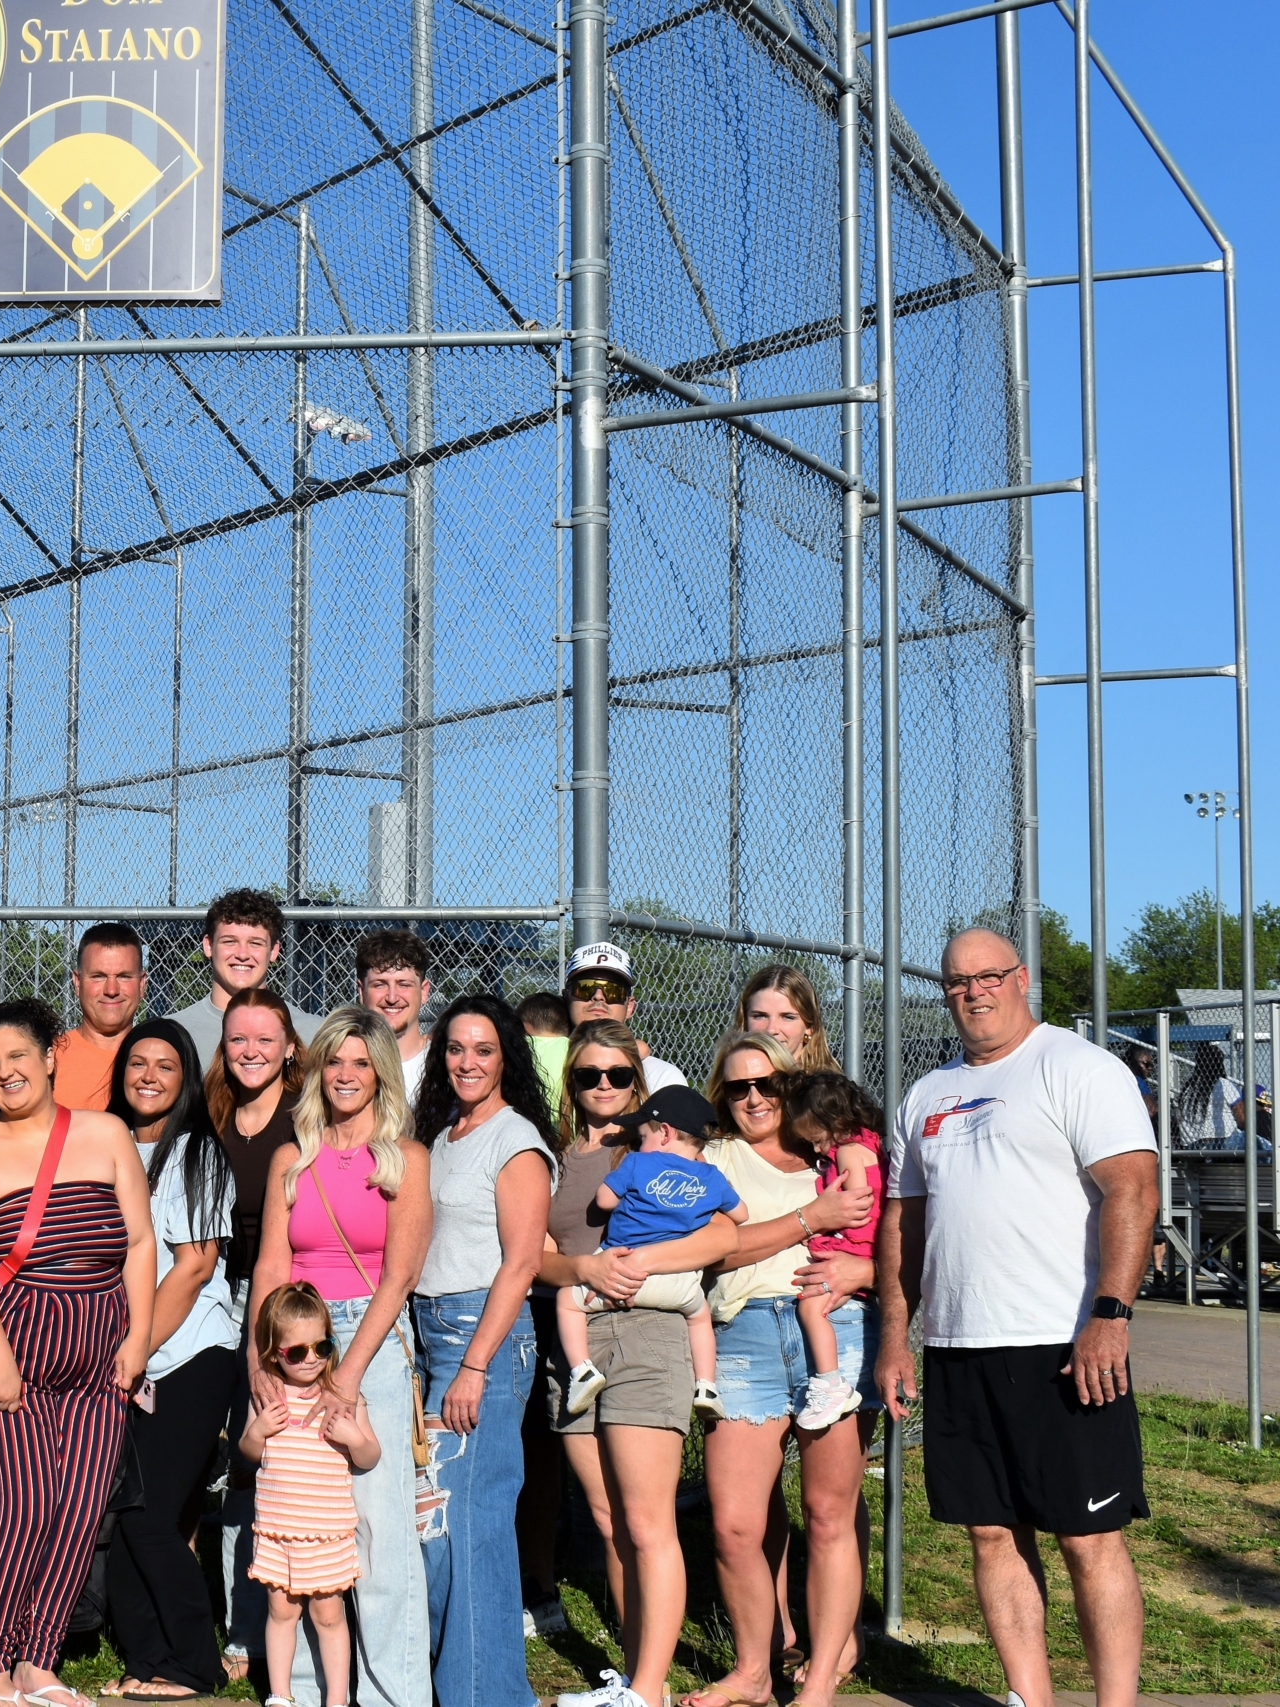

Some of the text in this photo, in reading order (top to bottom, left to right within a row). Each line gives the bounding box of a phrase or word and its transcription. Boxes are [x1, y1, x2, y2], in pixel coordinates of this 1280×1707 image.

[20, 18, 202, 64] STAIANO
[582, 945, 623, 963] PHILLIES
[646, 1177, 707, 1200] Old Navy
